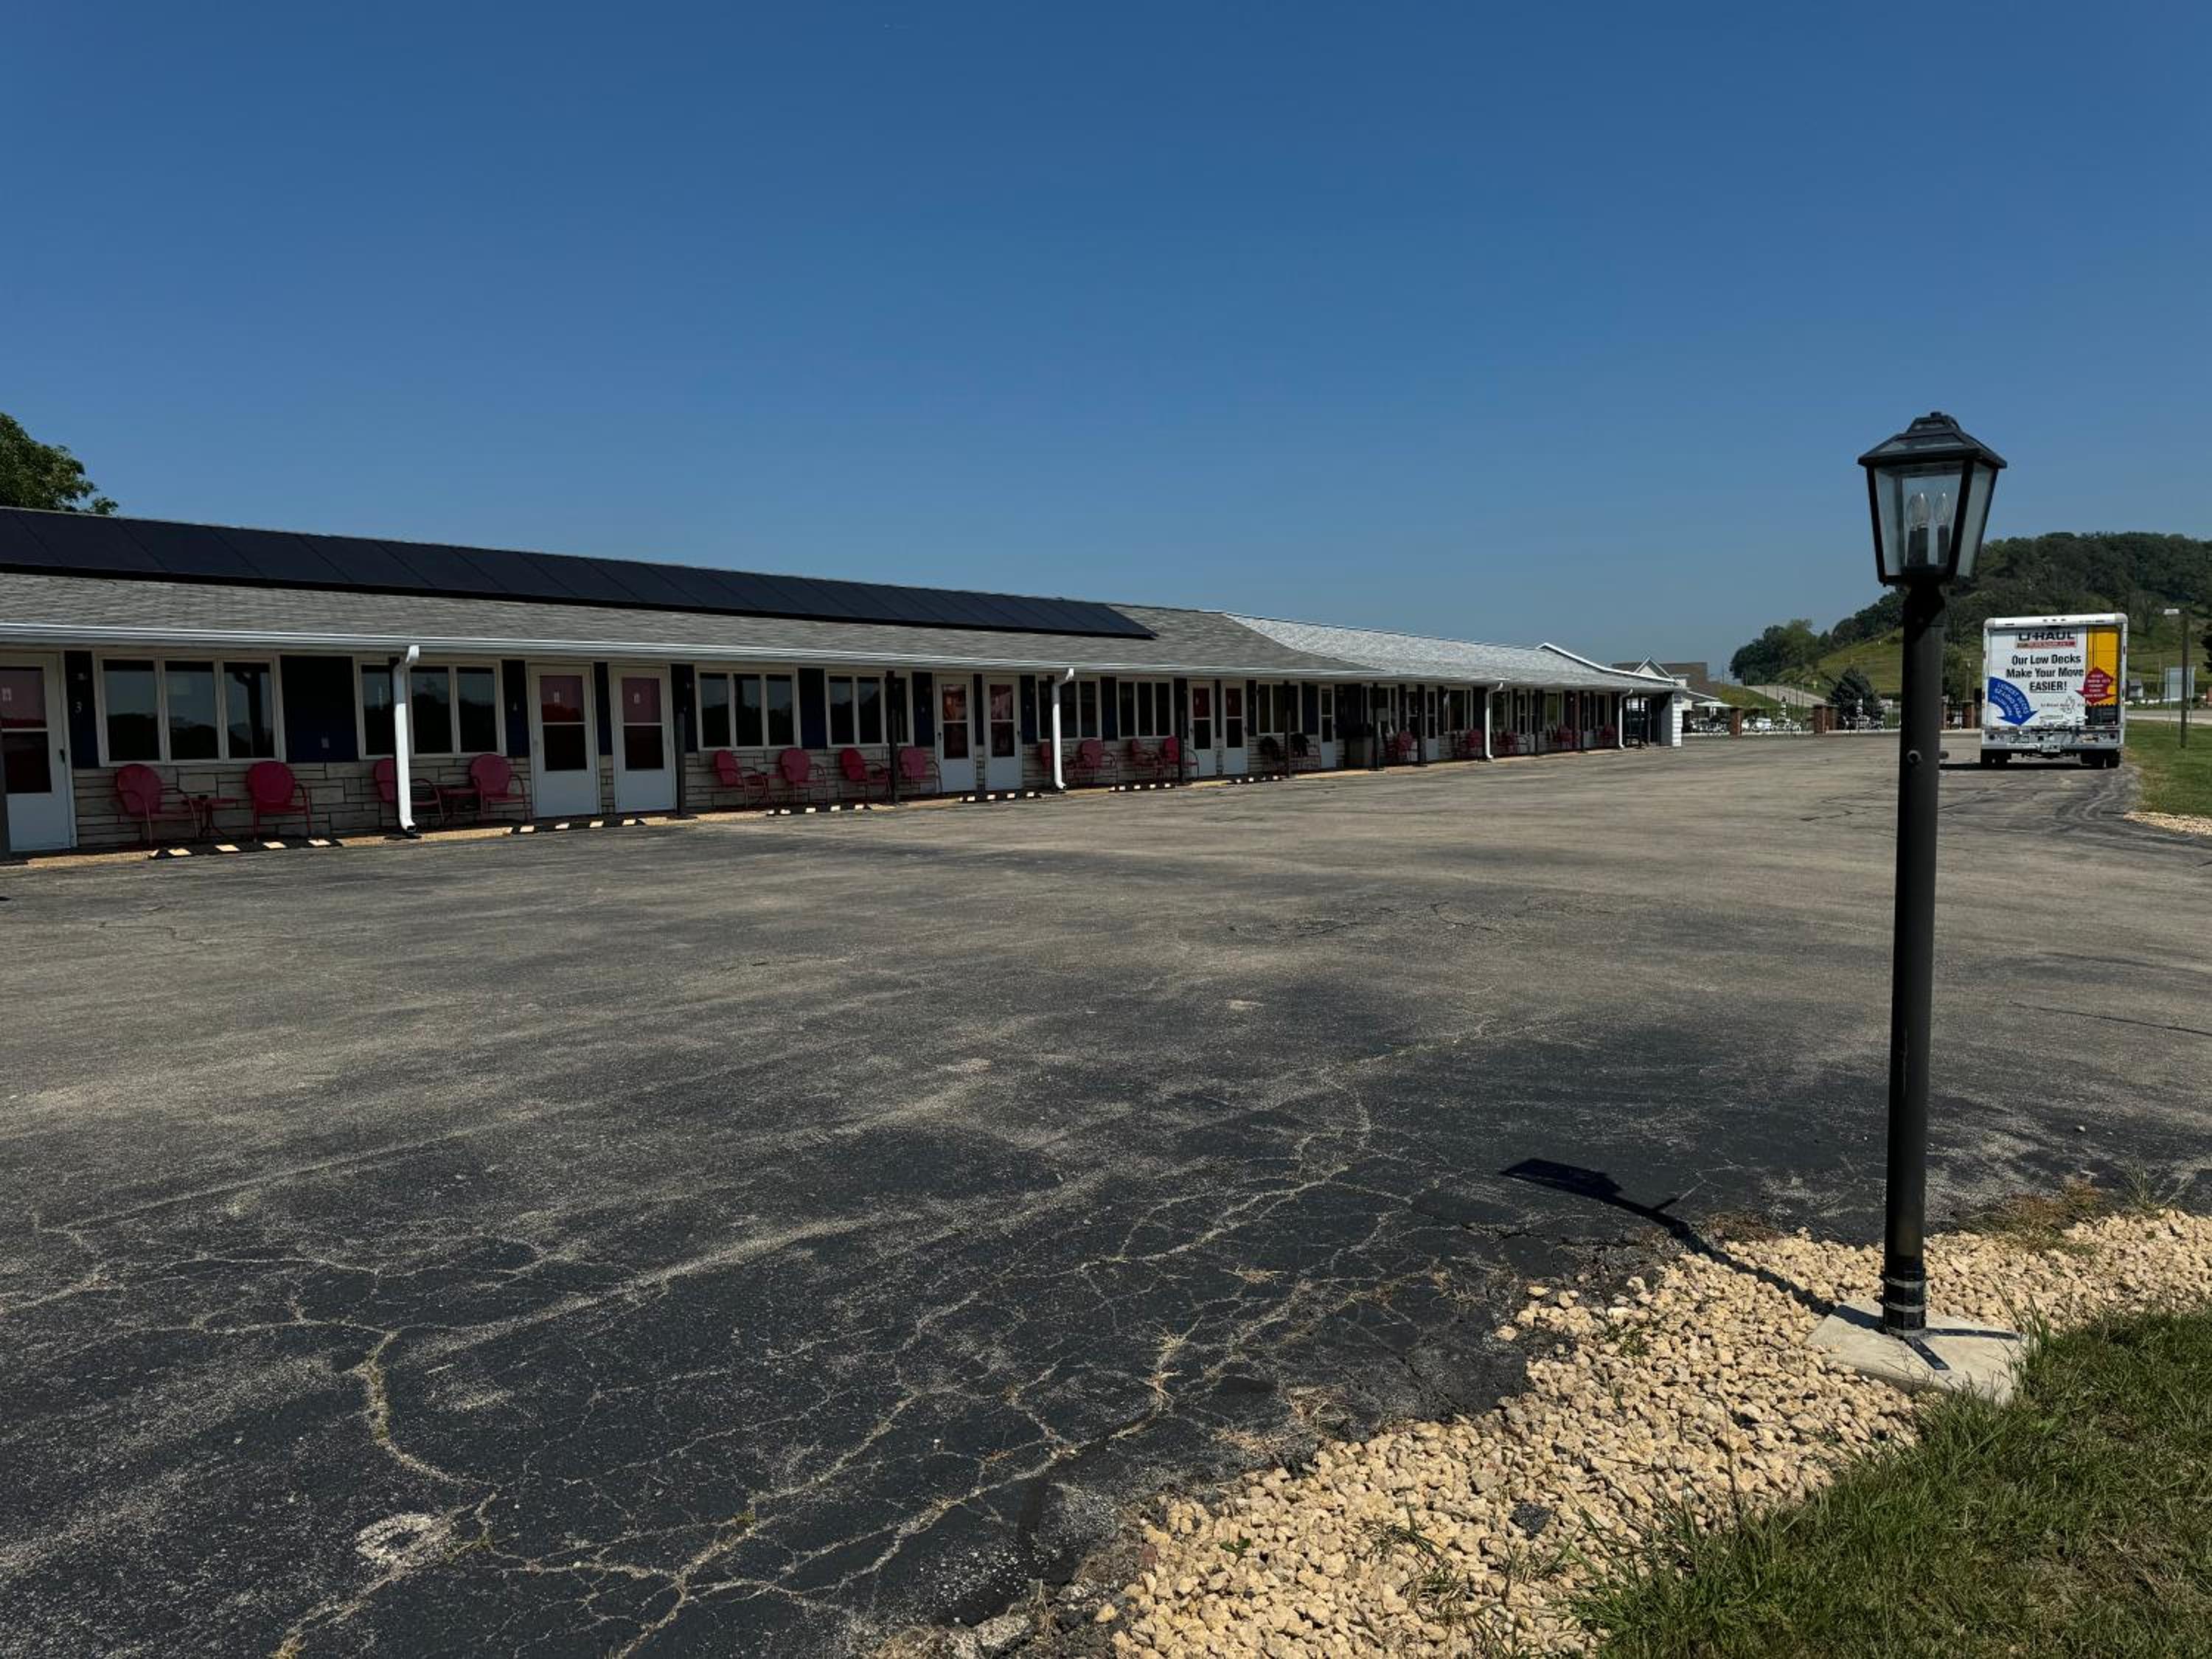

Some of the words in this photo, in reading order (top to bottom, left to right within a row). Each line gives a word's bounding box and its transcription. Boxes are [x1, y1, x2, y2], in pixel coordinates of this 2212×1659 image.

[2018, 631, 2076, 641] U-HAUL
[2012, 655, 2028, 665] Our
[2030, 654, 2049, 664] Low
[2051, 654, 2081, 664] Decks
[2006, 668, 2033, 678] Make
[2034, 667, 2056, 678] Your
[2058, 667, 2084, 678] Move
[2030, 681, 2067, 691] EASIER!
